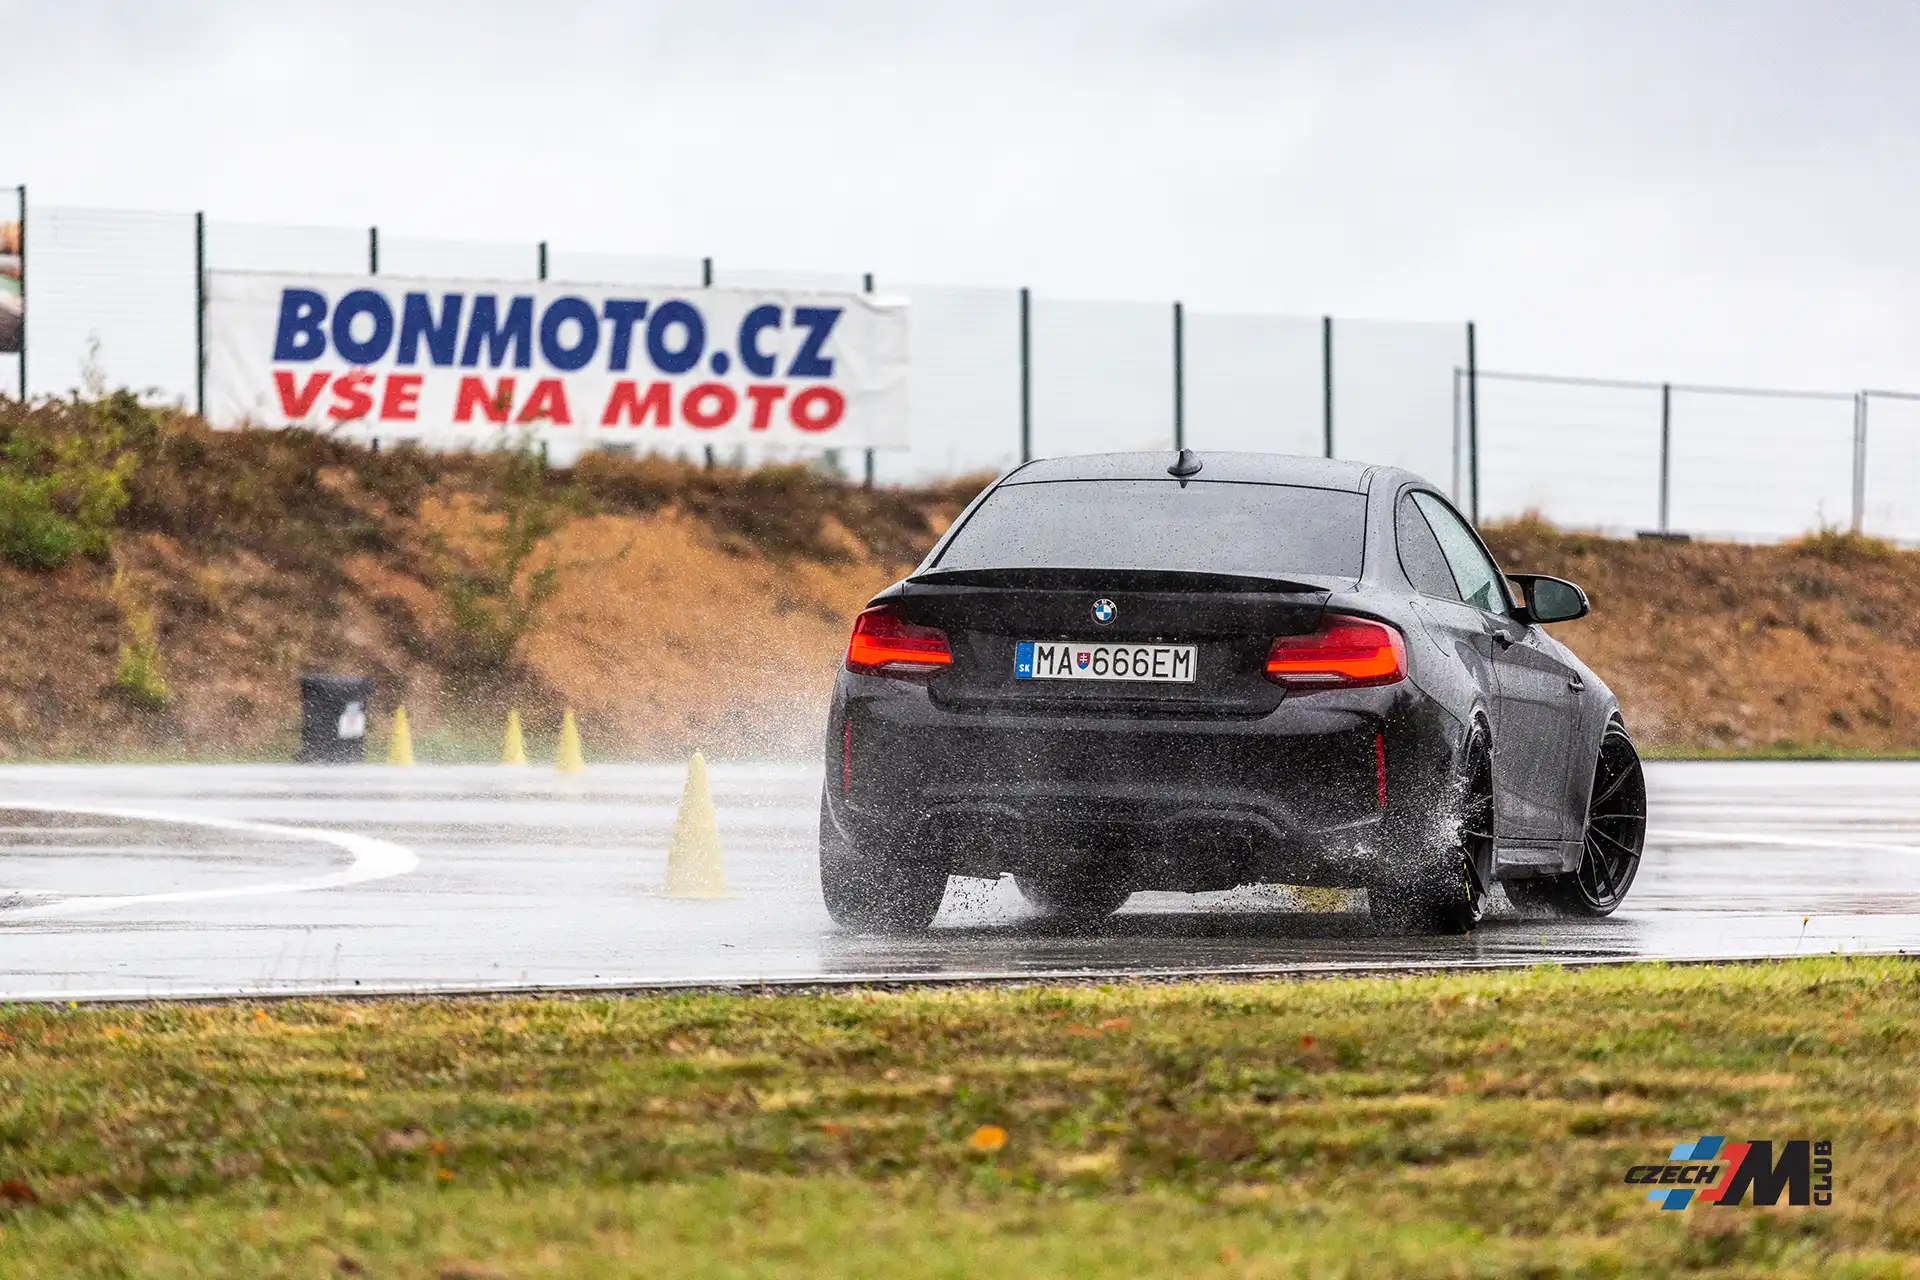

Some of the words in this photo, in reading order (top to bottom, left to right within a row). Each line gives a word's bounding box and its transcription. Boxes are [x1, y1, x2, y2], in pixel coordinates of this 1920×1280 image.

[273, 287, 843, 378] BONMOTO.CZ
[273, 367, 423, 422] VŠE
[454, 376, 572, 425] NA
[600, 381, 845, 432] MOTO
[1019, 664, 1030, 673] SK
[1036, 646, 1073, 675] MA
[1092, 647, 1190, 678] 666EM
